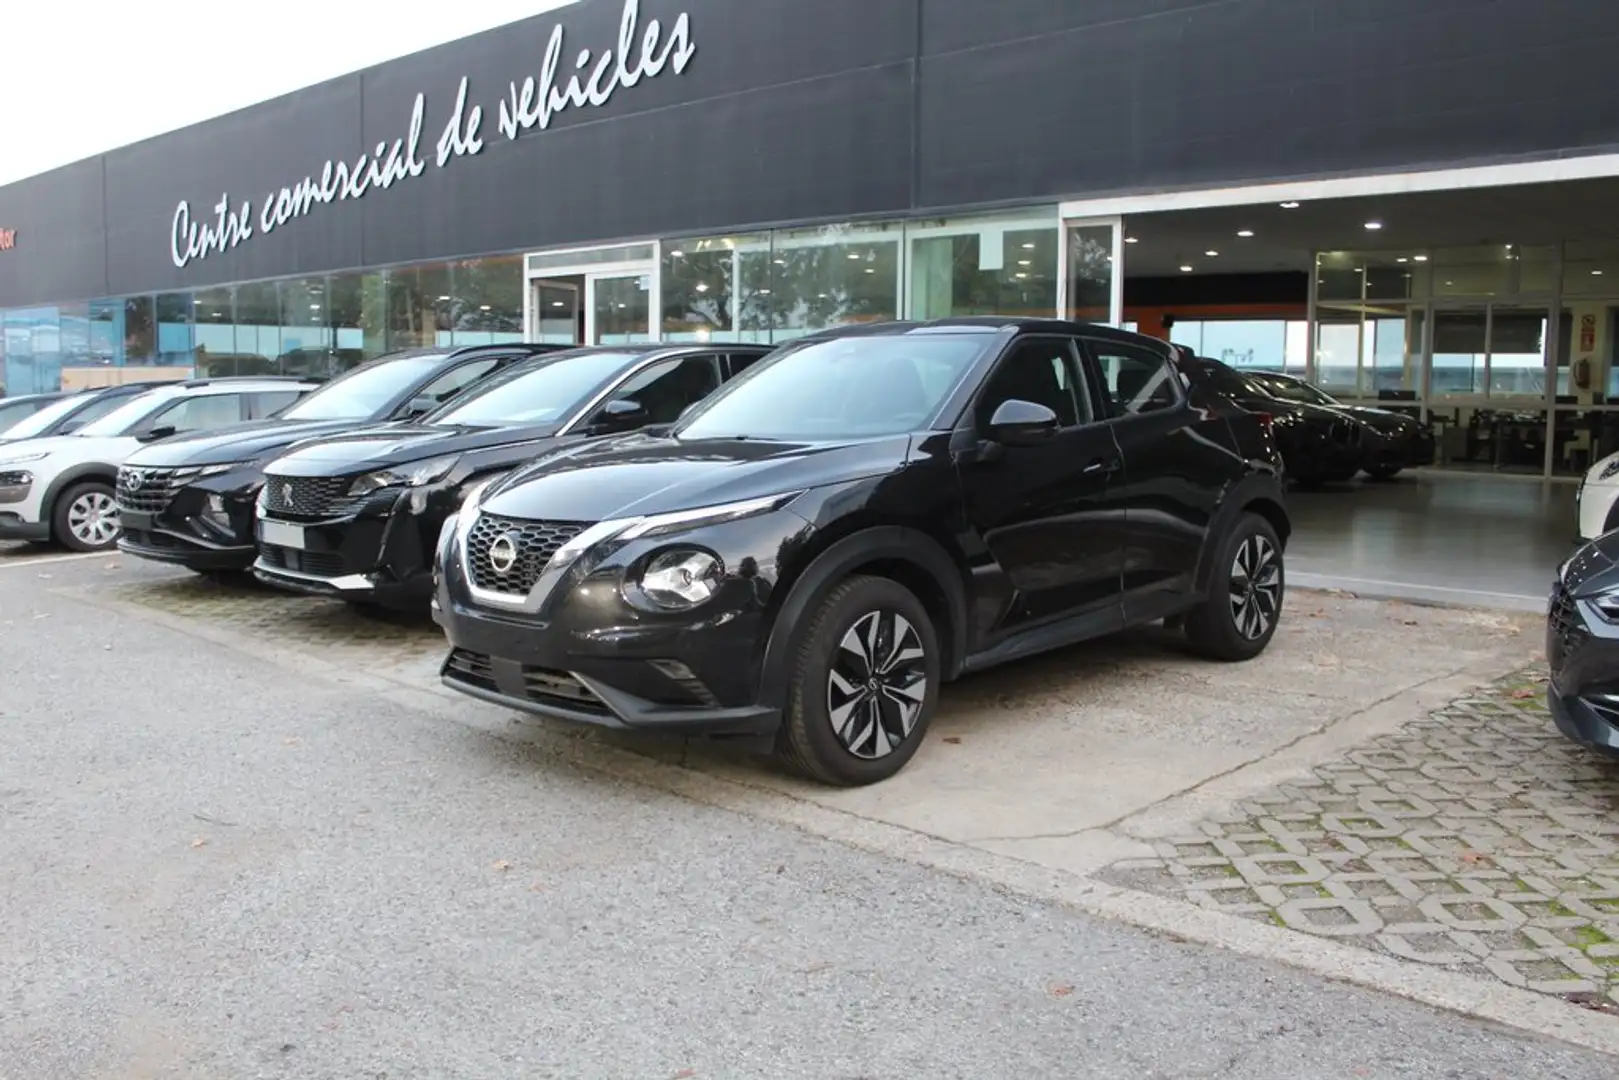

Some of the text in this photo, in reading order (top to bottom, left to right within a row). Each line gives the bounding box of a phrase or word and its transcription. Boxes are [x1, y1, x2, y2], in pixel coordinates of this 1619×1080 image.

[171, 0, 695, 268] Centre comercial de vehicles
